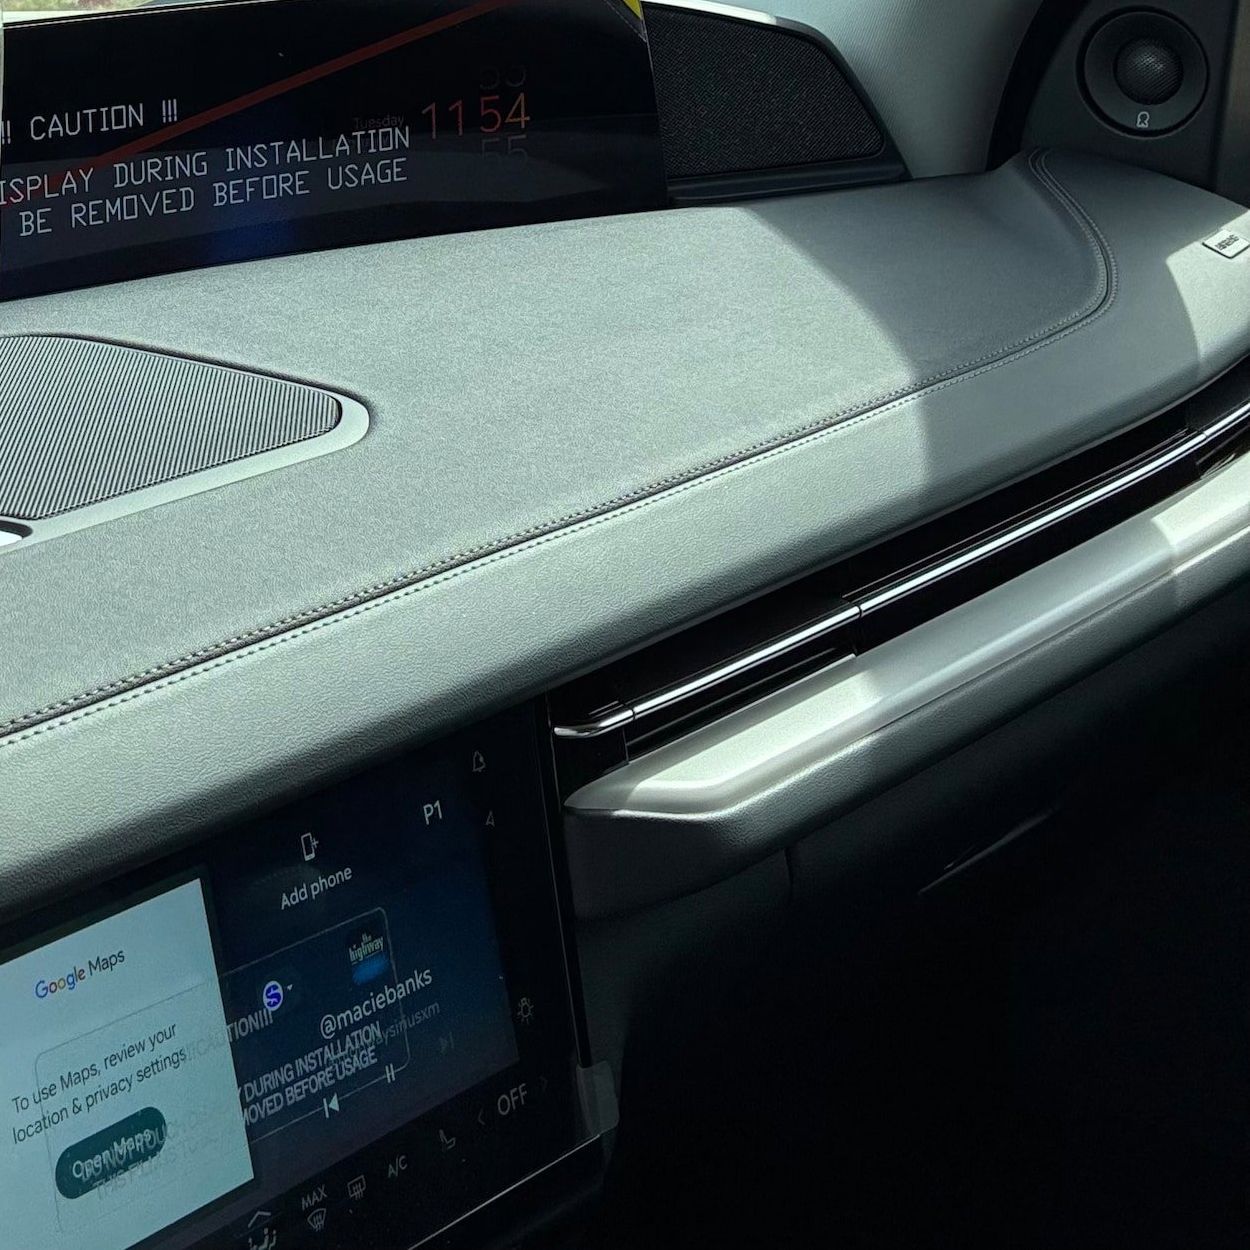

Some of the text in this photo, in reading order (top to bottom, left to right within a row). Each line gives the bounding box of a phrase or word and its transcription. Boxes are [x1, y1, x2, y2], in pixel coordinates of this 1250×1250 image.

[30, 102, 144, 141] CAUTION
[113, 151, 209, 189] DURING
[226, 125, 410, 172] INSTALLATION
[19, 208, 53, 238] BE
[71, 186, 195, 229] REMOVED
[213, 171, 310, 207] BEFORE
[328, 157, 408, 190] USAGE
[422, 799, 443, 826] P1
[281, 867, 352, 910] Add phone
[34, 949, 126, 1000] Google Maps
[349, 936, 384, 962] highway
[319, 969, 433, 1039] @maciebanks
[12, 1022, 178, 1115] To use Maps, review your
[243, 1020, 384, 1103] DURING INSTALLATION
[284, 1063, 336, 1107] BEFORE
[334, 1045, 379, 1082] USAGE
[12, 1047, 188, 1145] location & privacy settings
[497, 1082, 528, 1117] OFF
[387, 1154, 409, 1179] A/C
[301, 1183, 328, 1211] MAX
